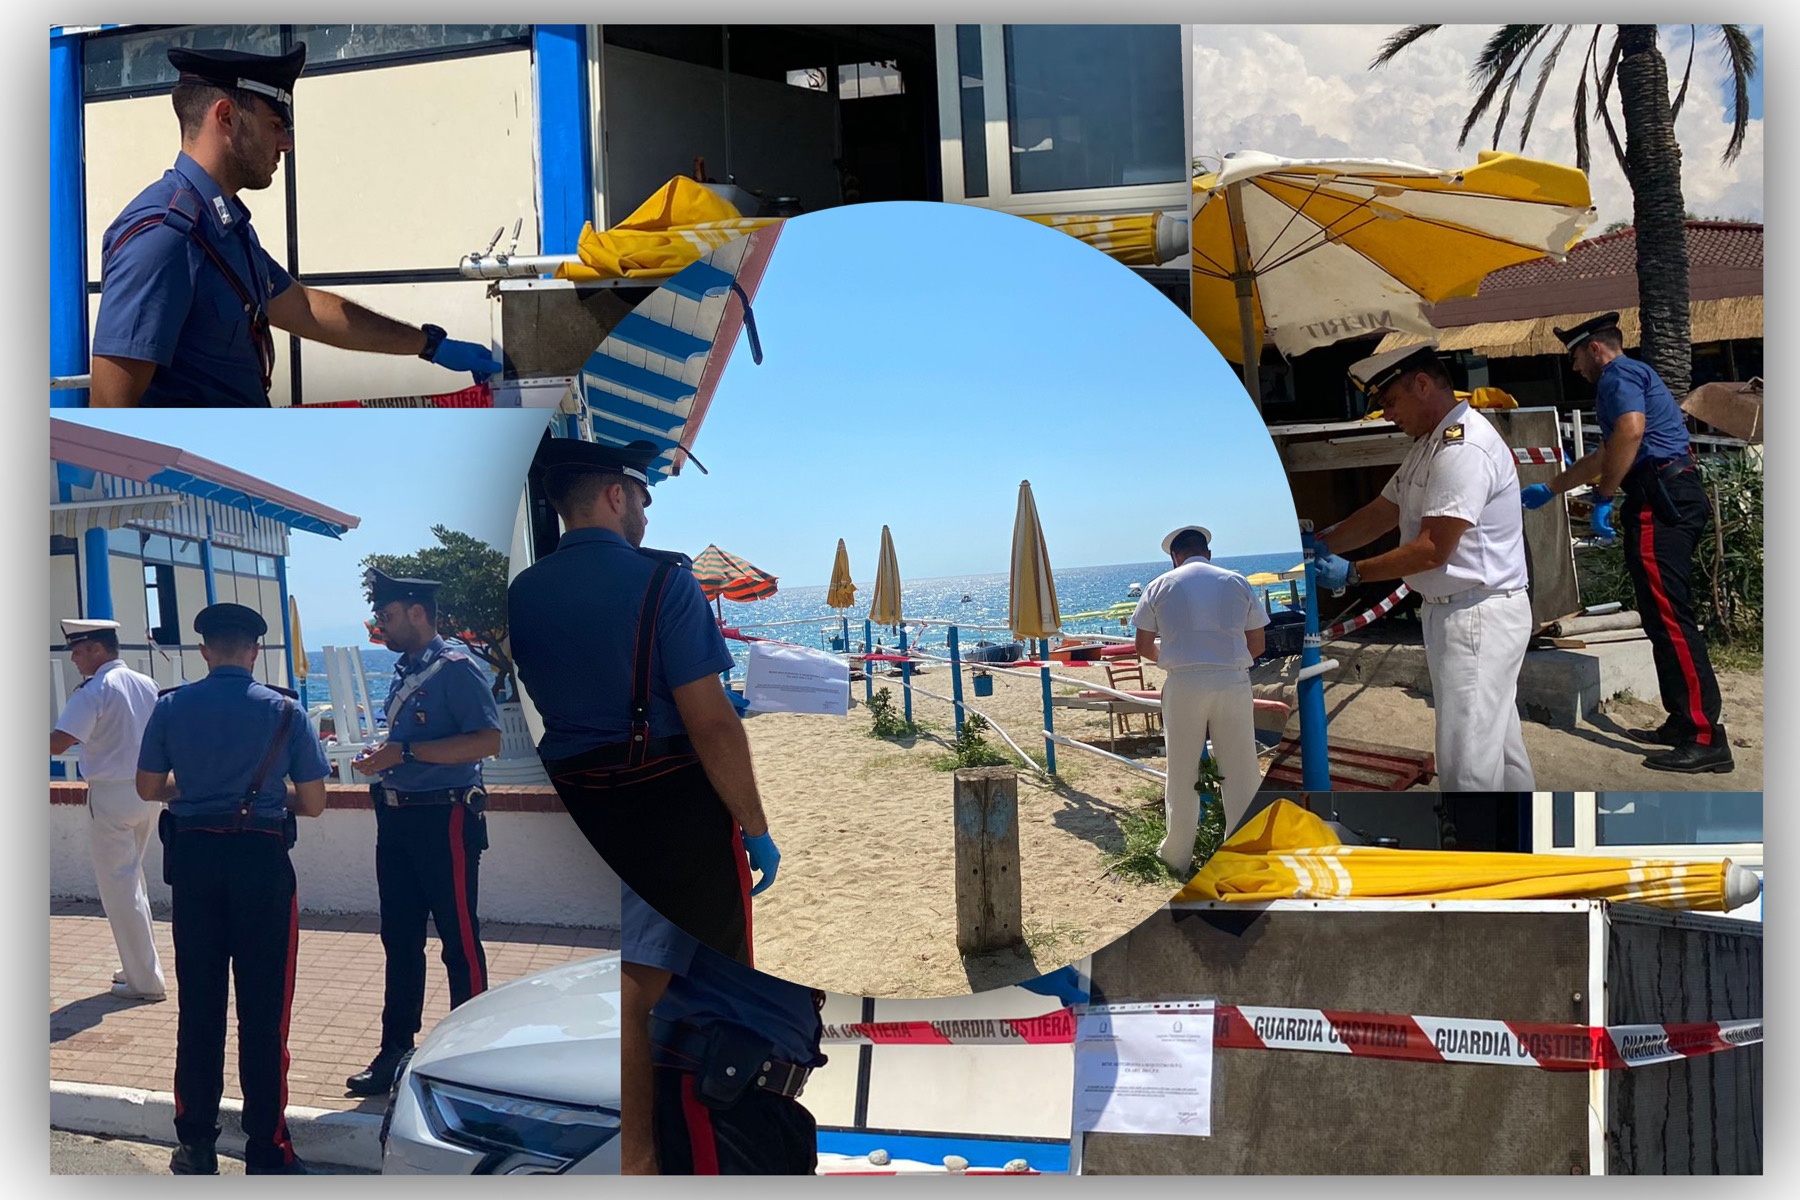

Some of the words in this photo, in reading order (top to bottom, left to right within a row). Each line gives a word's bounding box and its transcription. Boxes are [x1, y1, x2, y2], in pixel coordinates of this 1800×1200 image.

[931, 1020, 996, 1038] GUARDIA
[1000, 1016, 1071, 1038] COSTIERA
[1254, 1016, 1323, 1042] GUARDIA
[1328, 1020, 1408, 1048] COSTIERA
[1434, 1027, 1511, 1057] GUARDIA
[1517, 1032, 1605, 1060] COSTIERA
